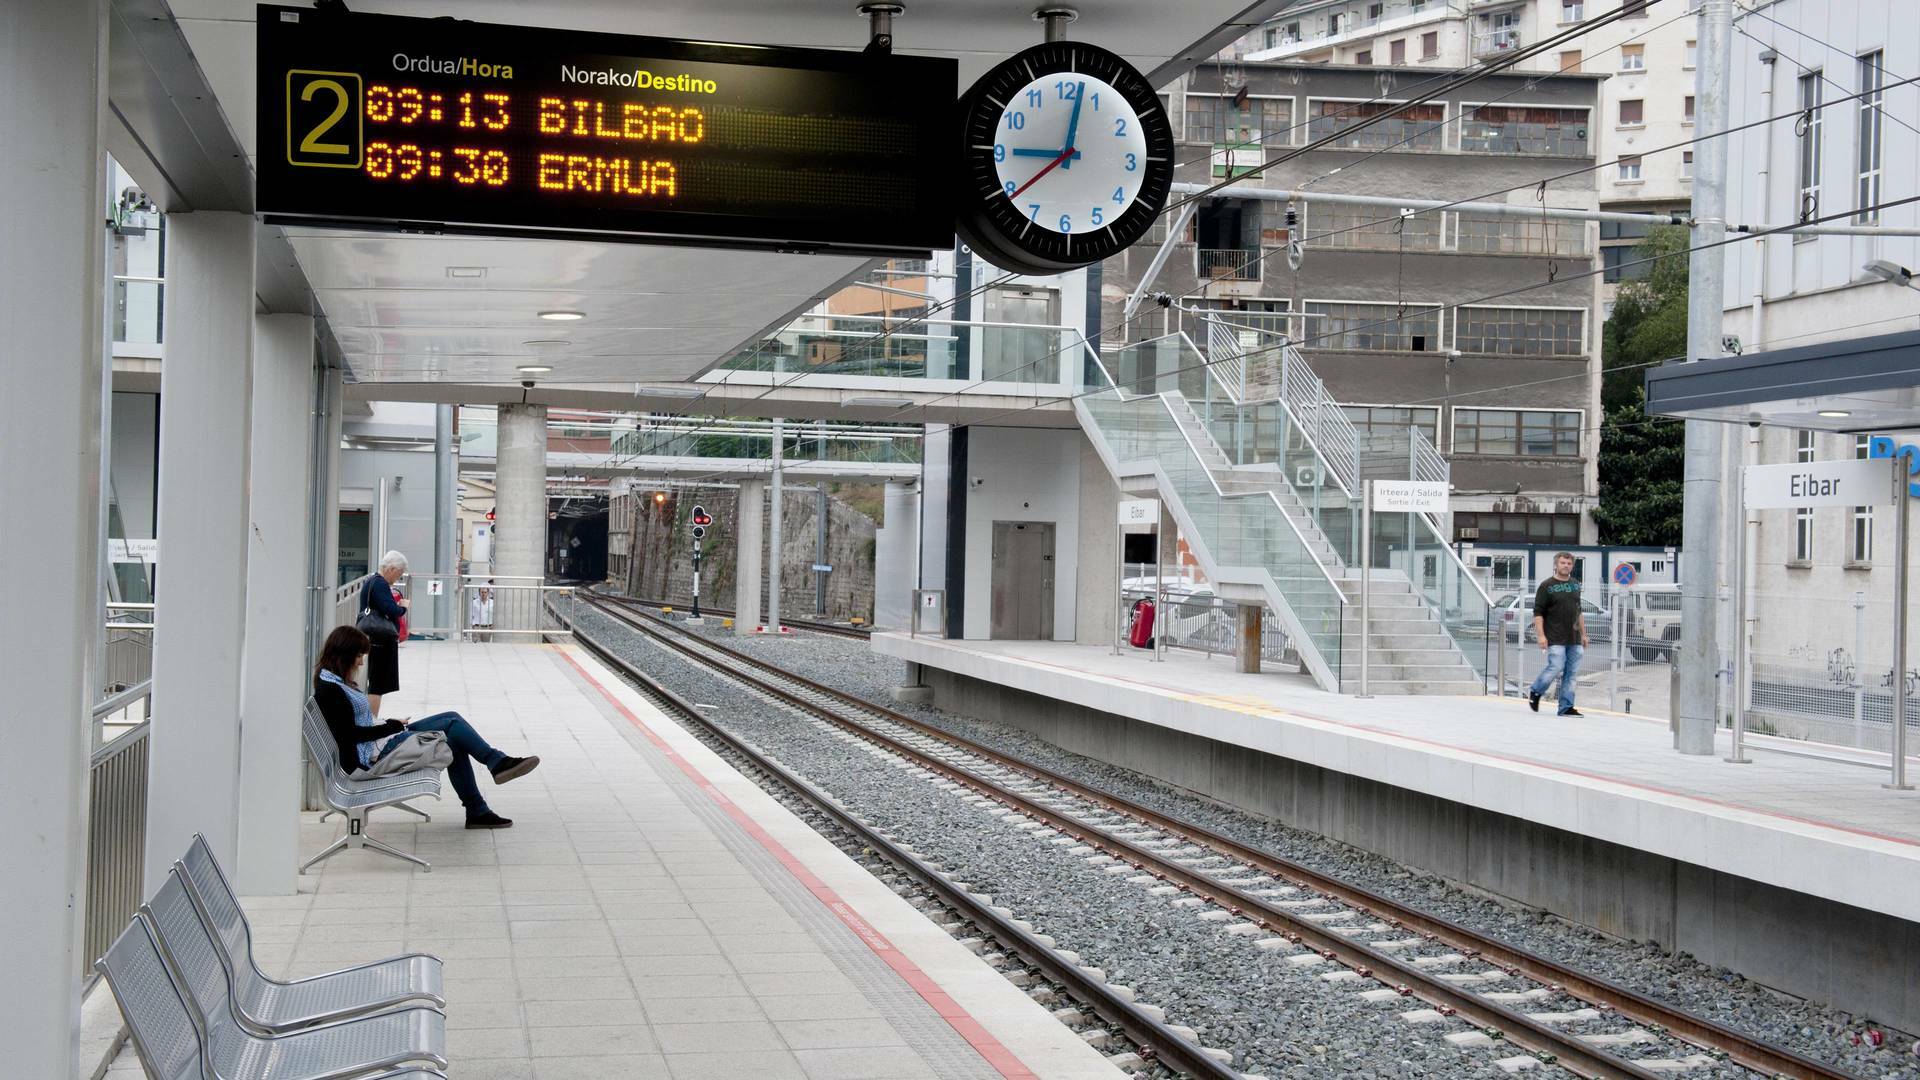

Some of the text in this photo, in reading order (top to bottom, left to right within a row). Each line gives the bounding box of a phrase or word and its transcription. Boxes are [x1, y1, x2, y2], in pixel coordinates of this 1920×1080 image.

[392, 53, 514, 79] Ordua/Hora
[561, 65, 717, 94] Norako/Destino
[1026, 89, 1042, 108] 11
[1055, 81, 1076, 100] 12
[1090, 93, 1099, 111] 1
[300, 79, 350, 155] 2
[367, 86, 703, 143] 09:13 BILBAO
[1004, 112, 1025, 130] 10
[1115, 119, 1127, 137] 2
[994, 144, 1005, 162] 9
[1125, 153, 1136, 171] 3
[366, 142, 676, 196] 09:30 ERMUA
[1112, 186, 1124, 204] 4
[1028, 204, 1040, 222] 7
[1091, 207, 1103, 225] 5
[1059, 215, 1071, 233] 6
[1380, 488, 1409, 497] Irteera
[1417, 488, 1443, 497] Salida
[1790, 474, 1841, 498] Eibar
[1387, 498, 1409, 506] Sortie
